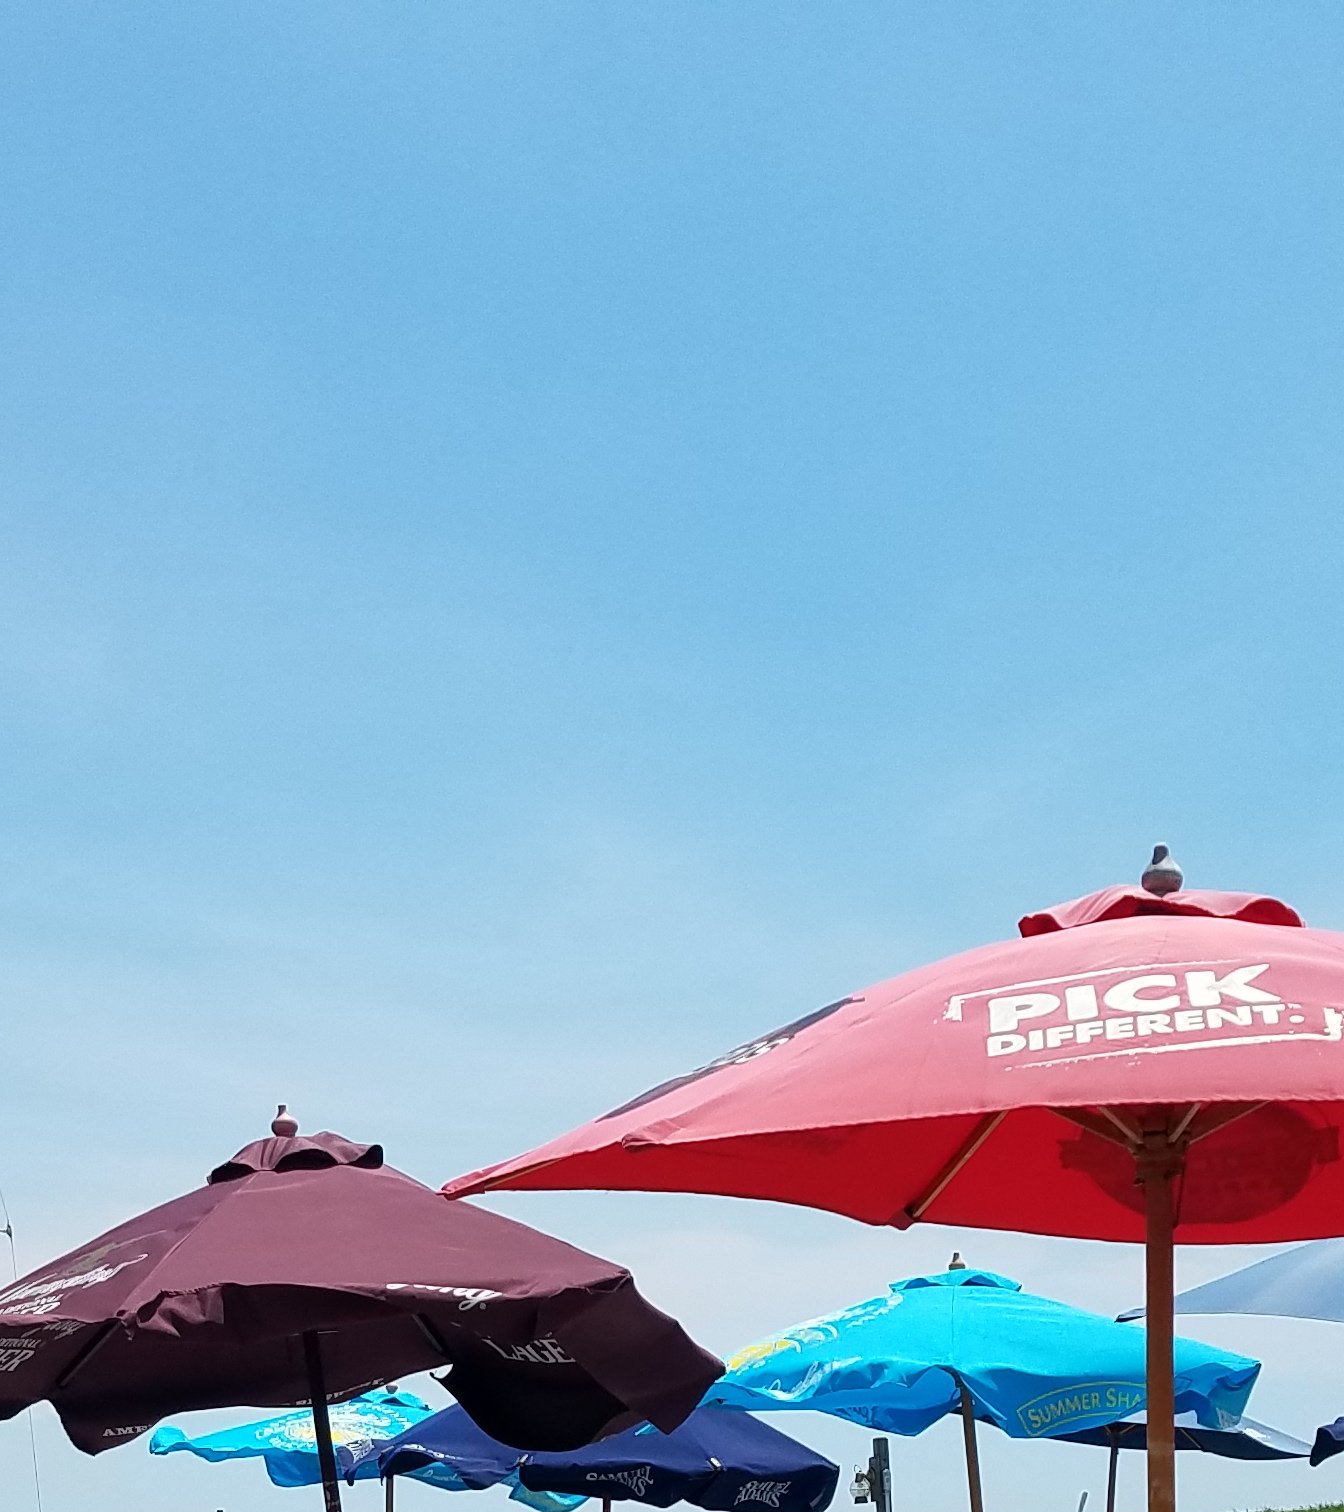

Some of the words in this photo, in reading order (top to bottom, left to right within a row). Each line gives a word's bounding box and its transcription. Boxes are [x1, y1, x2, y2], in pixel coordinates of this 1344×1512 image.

[988, 963, 1282, 1034] PICK
[481, 1337, 577, 1364] LAGE
[1026, 1390, 1102, 1428] SUMMER
[1106, 1387, 1143, 1409] SHA
